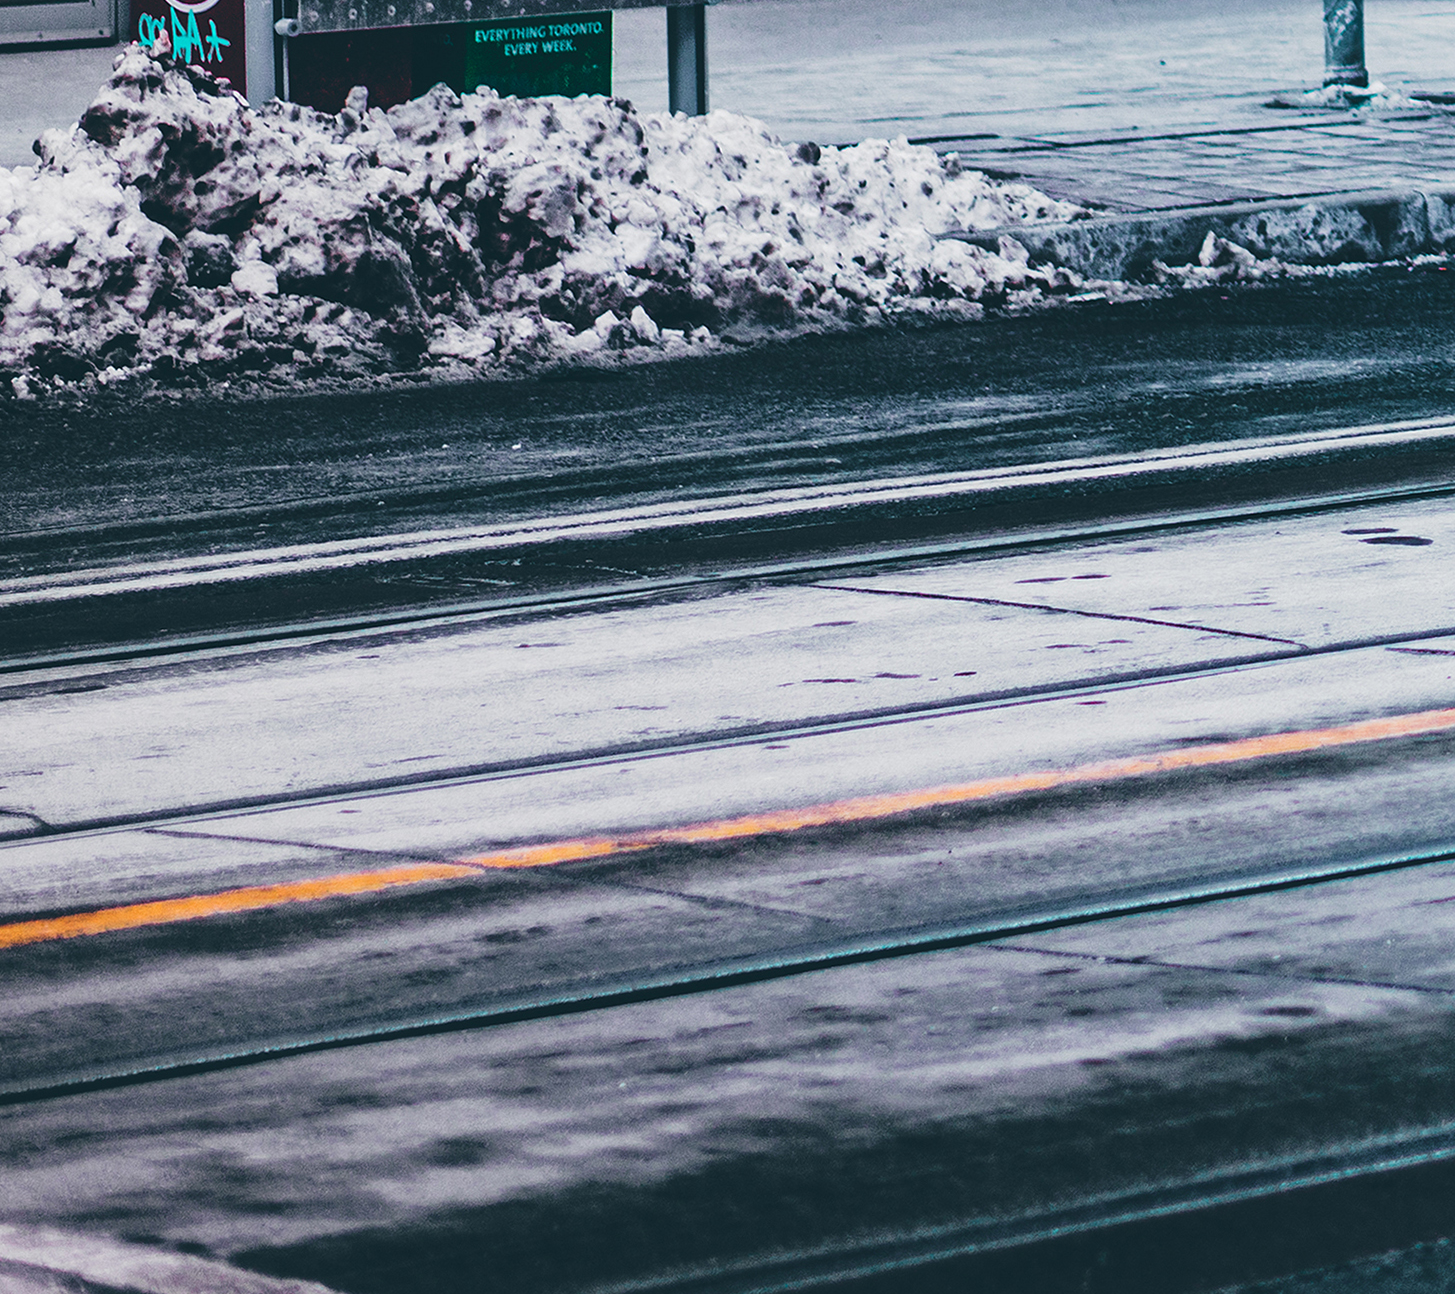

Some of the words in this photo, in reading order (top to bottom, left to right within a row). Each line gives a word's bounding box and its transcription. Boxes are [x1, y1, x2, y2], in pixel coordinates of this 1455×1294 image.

[474, 24, 547, 44] EVERYTHING
[503, 42, 539, 57] EVERY
[541, 38, 577, 53] WEEK.
